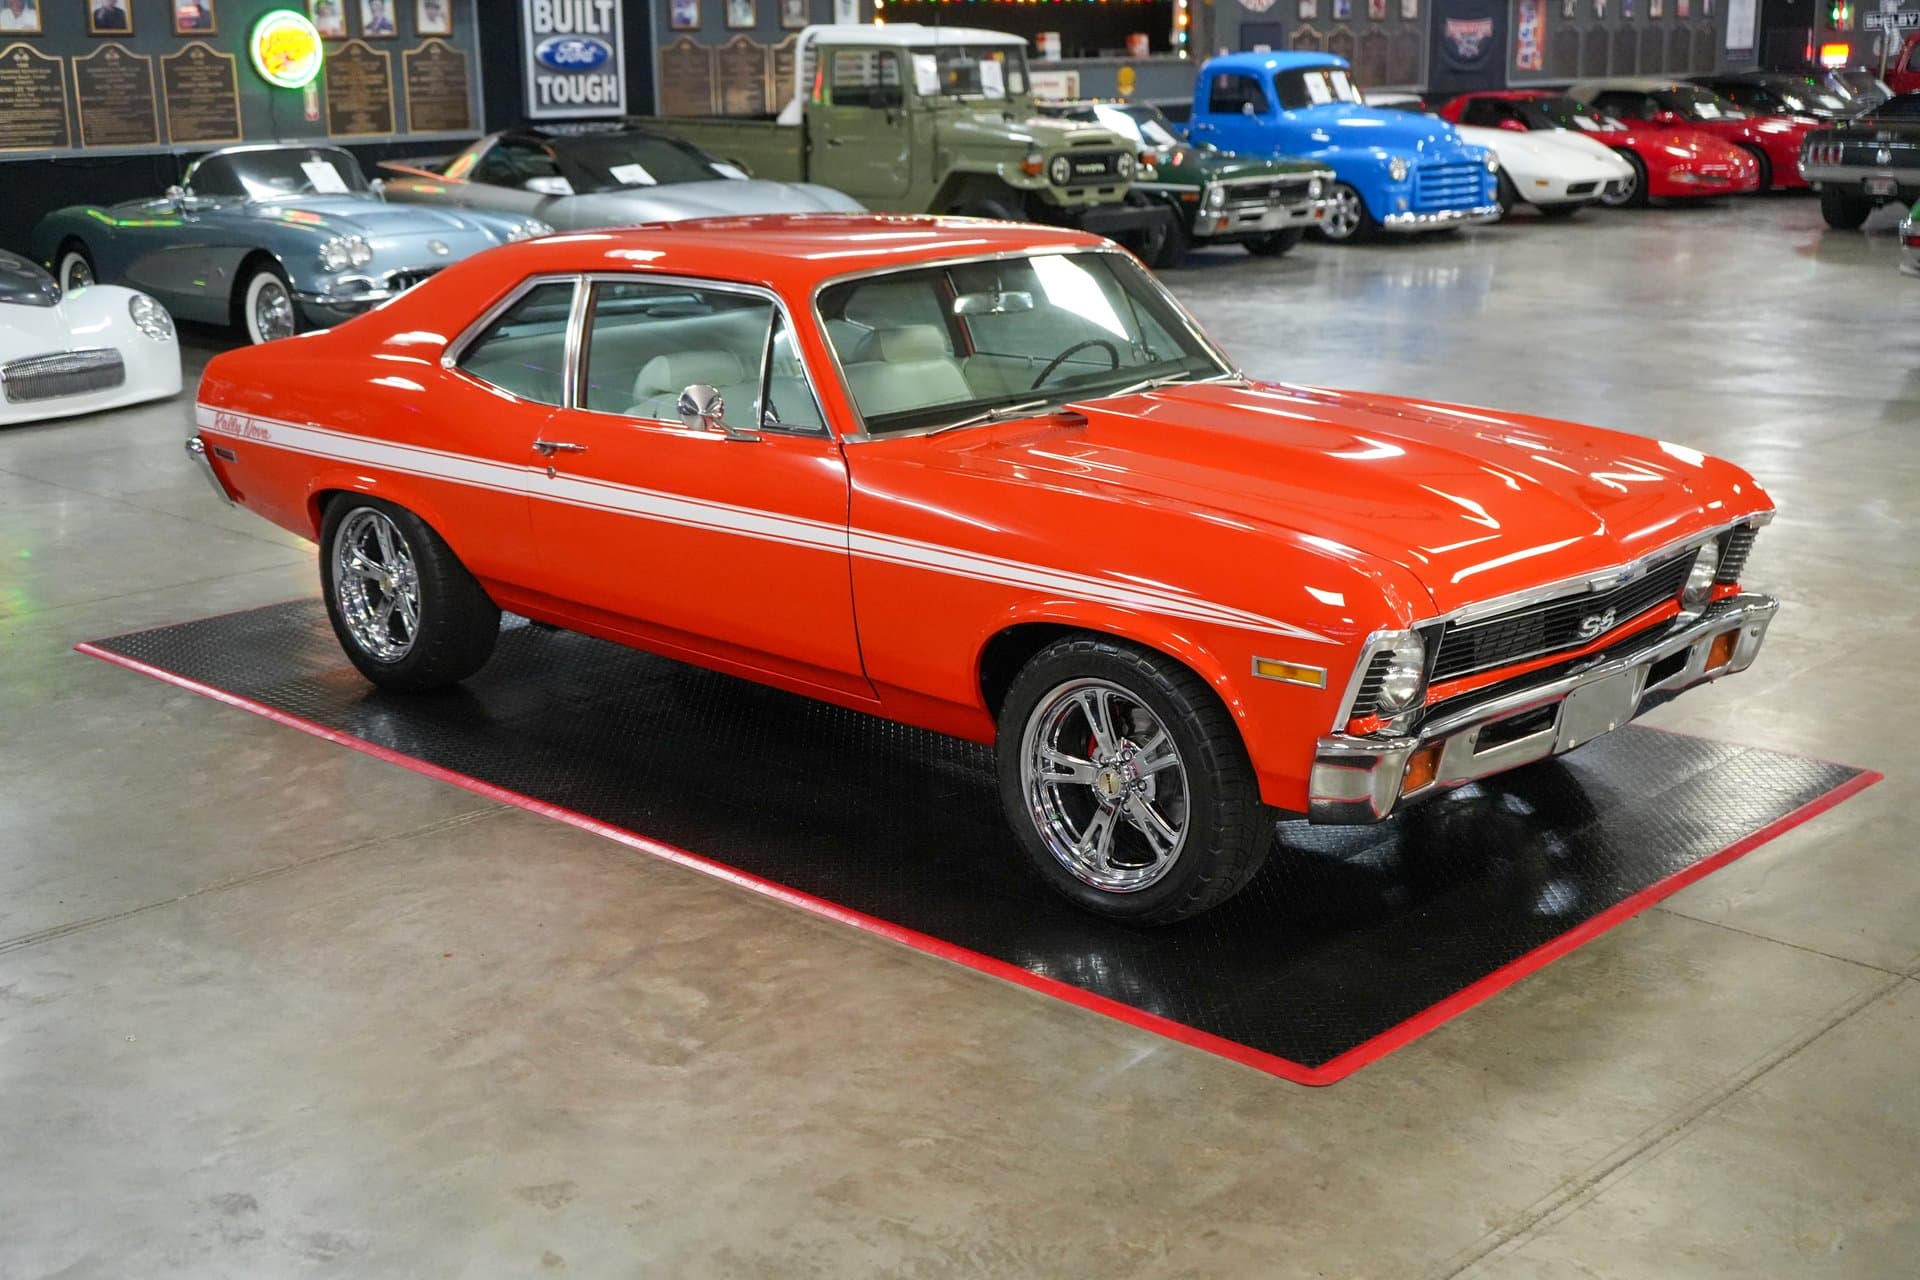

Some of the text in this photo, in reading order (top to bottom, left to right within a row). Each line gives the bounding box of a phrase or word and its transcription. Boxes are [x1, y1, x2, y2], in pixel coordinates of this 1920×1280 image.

[533, 0, 613, 33] BUILT
[555, 42, 598, 63] Ford
[537, 74, 617, 104] TOUGH
[213, 412, 272, 440] Rally Nova
[1577, 607, 1617, 638] SS
